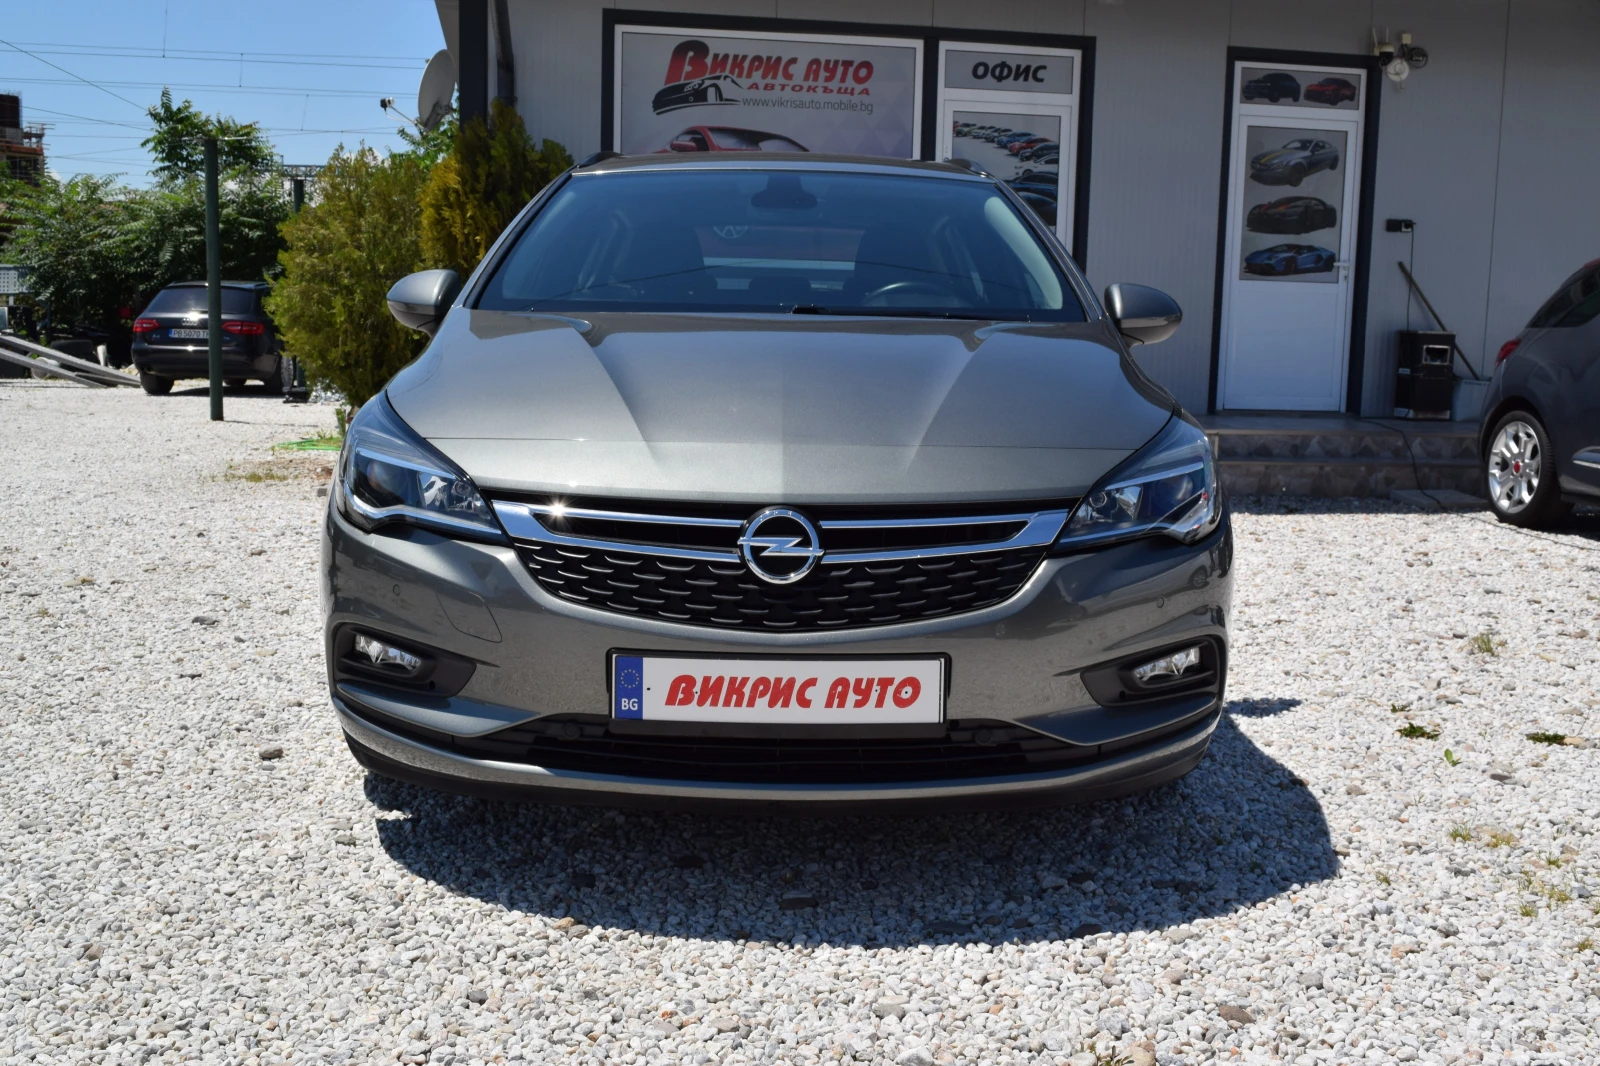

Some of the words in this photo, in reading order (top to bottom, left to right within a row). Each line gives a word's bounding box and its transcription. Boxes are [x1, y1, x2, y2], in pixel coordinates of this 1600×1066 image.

[803, 58, 874, 85] АУТО
[971, 61, 1047, 83] ОФИС
[747, 82, 871, 96] АВТОКЪЩА
[742, 97, 874, 115] www.vikrisauto.mobile.bg
[664, 674, 819, 708] ВИКРИС
[824, 676, 922, 709] АУТО
[621, 698, 639, 711] BG
